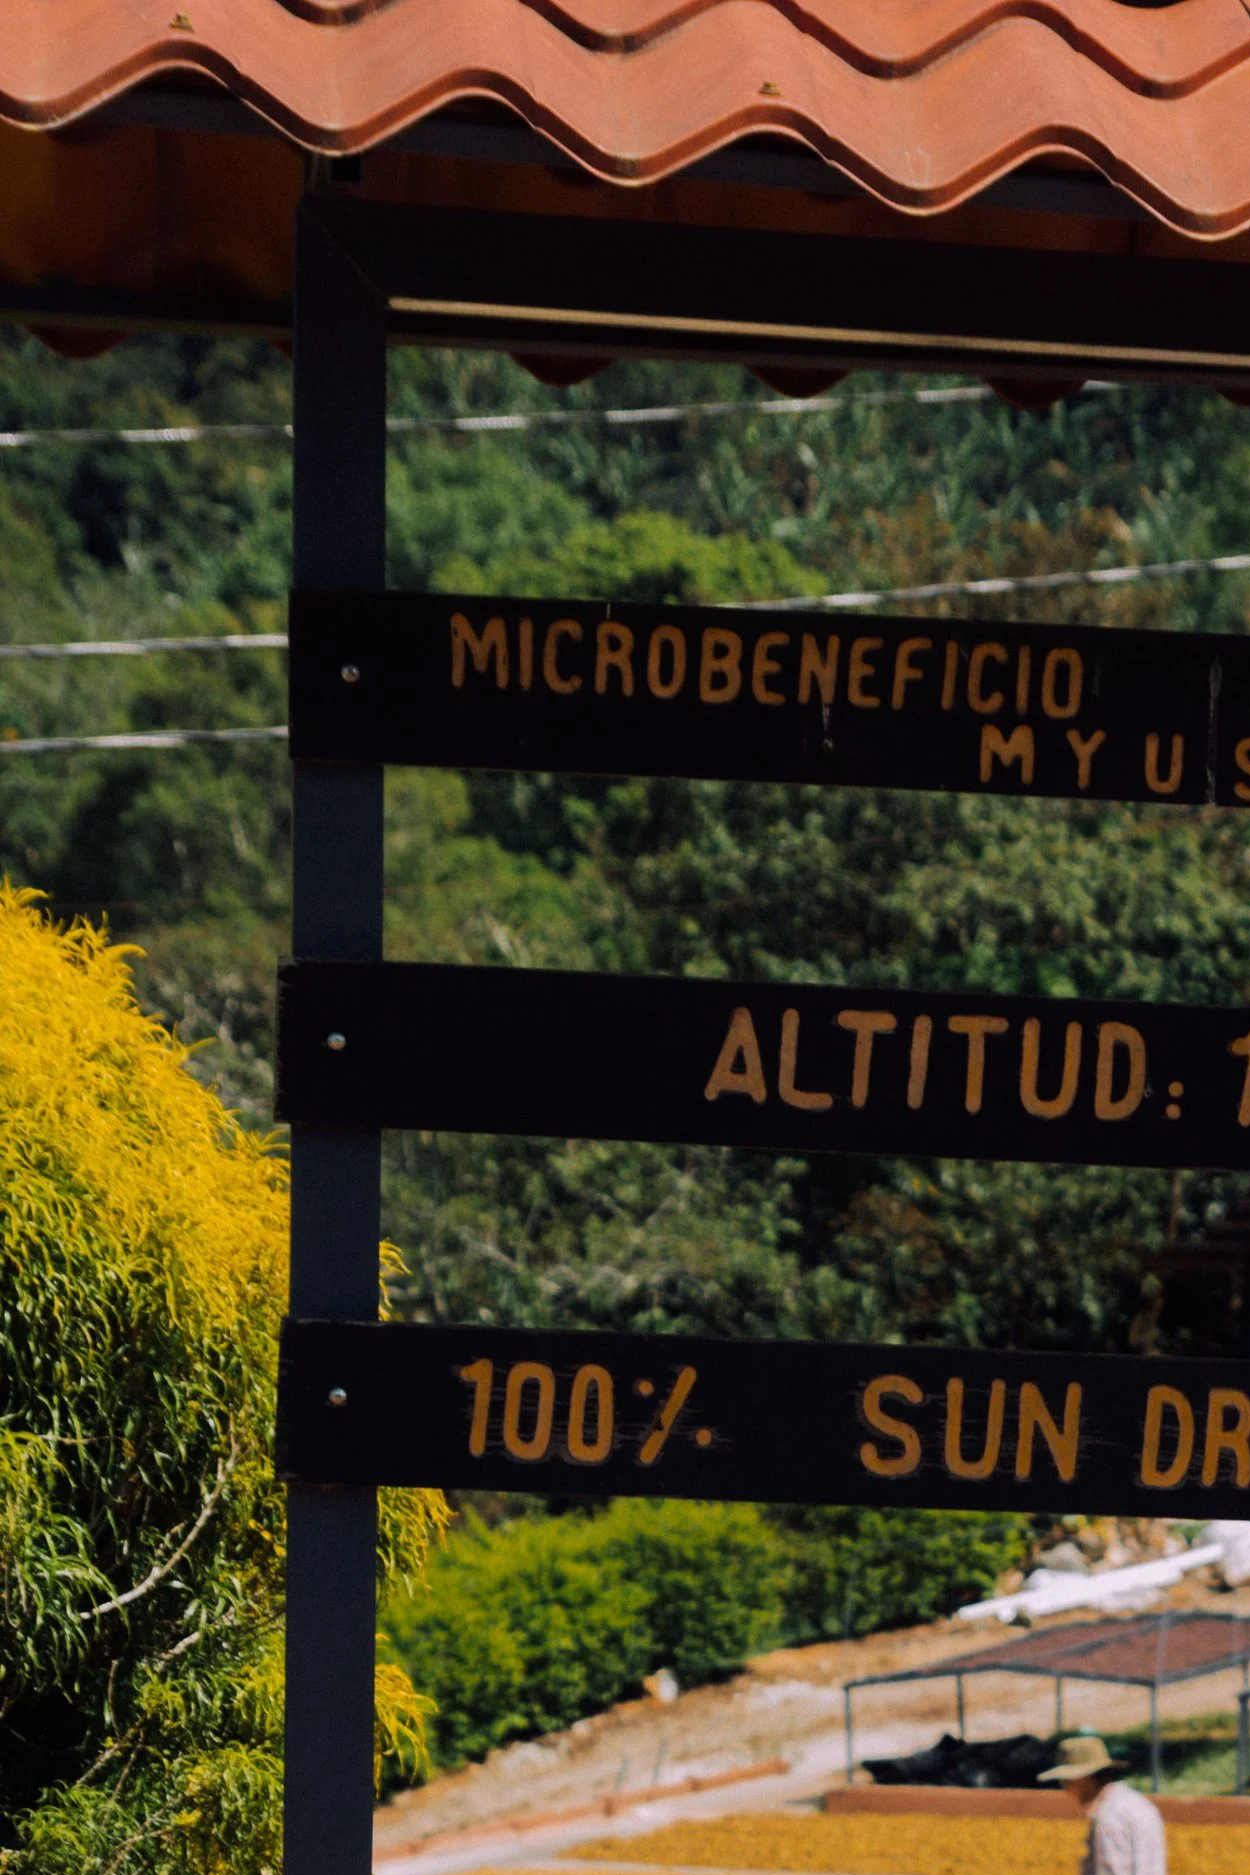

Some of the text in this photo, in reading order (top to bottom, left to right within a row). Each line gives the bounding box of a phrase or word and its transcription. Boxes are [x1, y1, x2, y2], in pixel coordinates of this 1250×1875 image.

[449, 609, 1087, 722] MICROBENEFICIO
[703, 1006, 1186, 1123] ALTITUD:
[858, 1373, 1085, 1484] SUN
